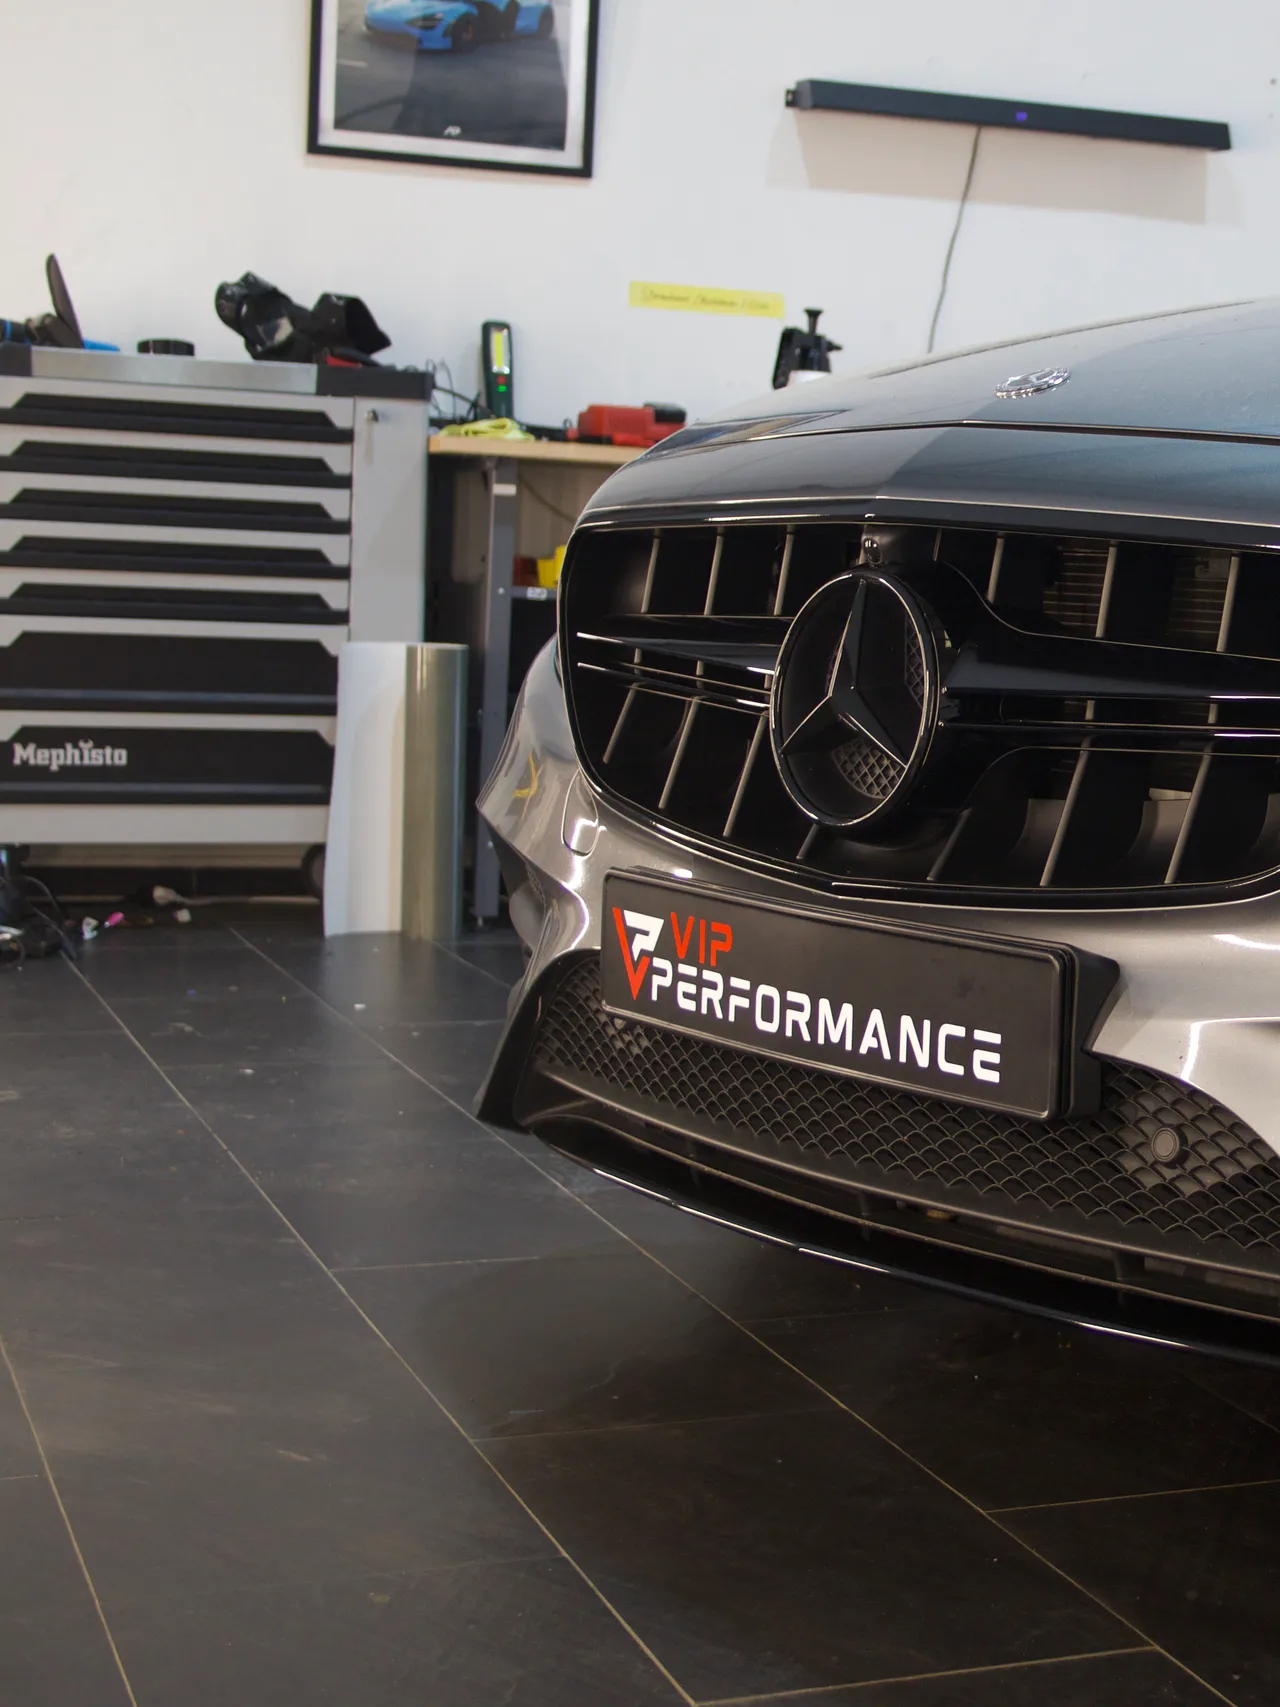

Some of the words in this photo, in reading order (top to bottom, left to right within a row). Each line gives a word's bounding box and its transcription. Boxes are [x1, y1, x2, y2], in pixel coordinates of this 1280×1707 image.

[13, 739, 128, 772] Mephisto
[670, 911, 733, 967] VIP
[651, 956, 1002, 1084] PERFORMANCE
